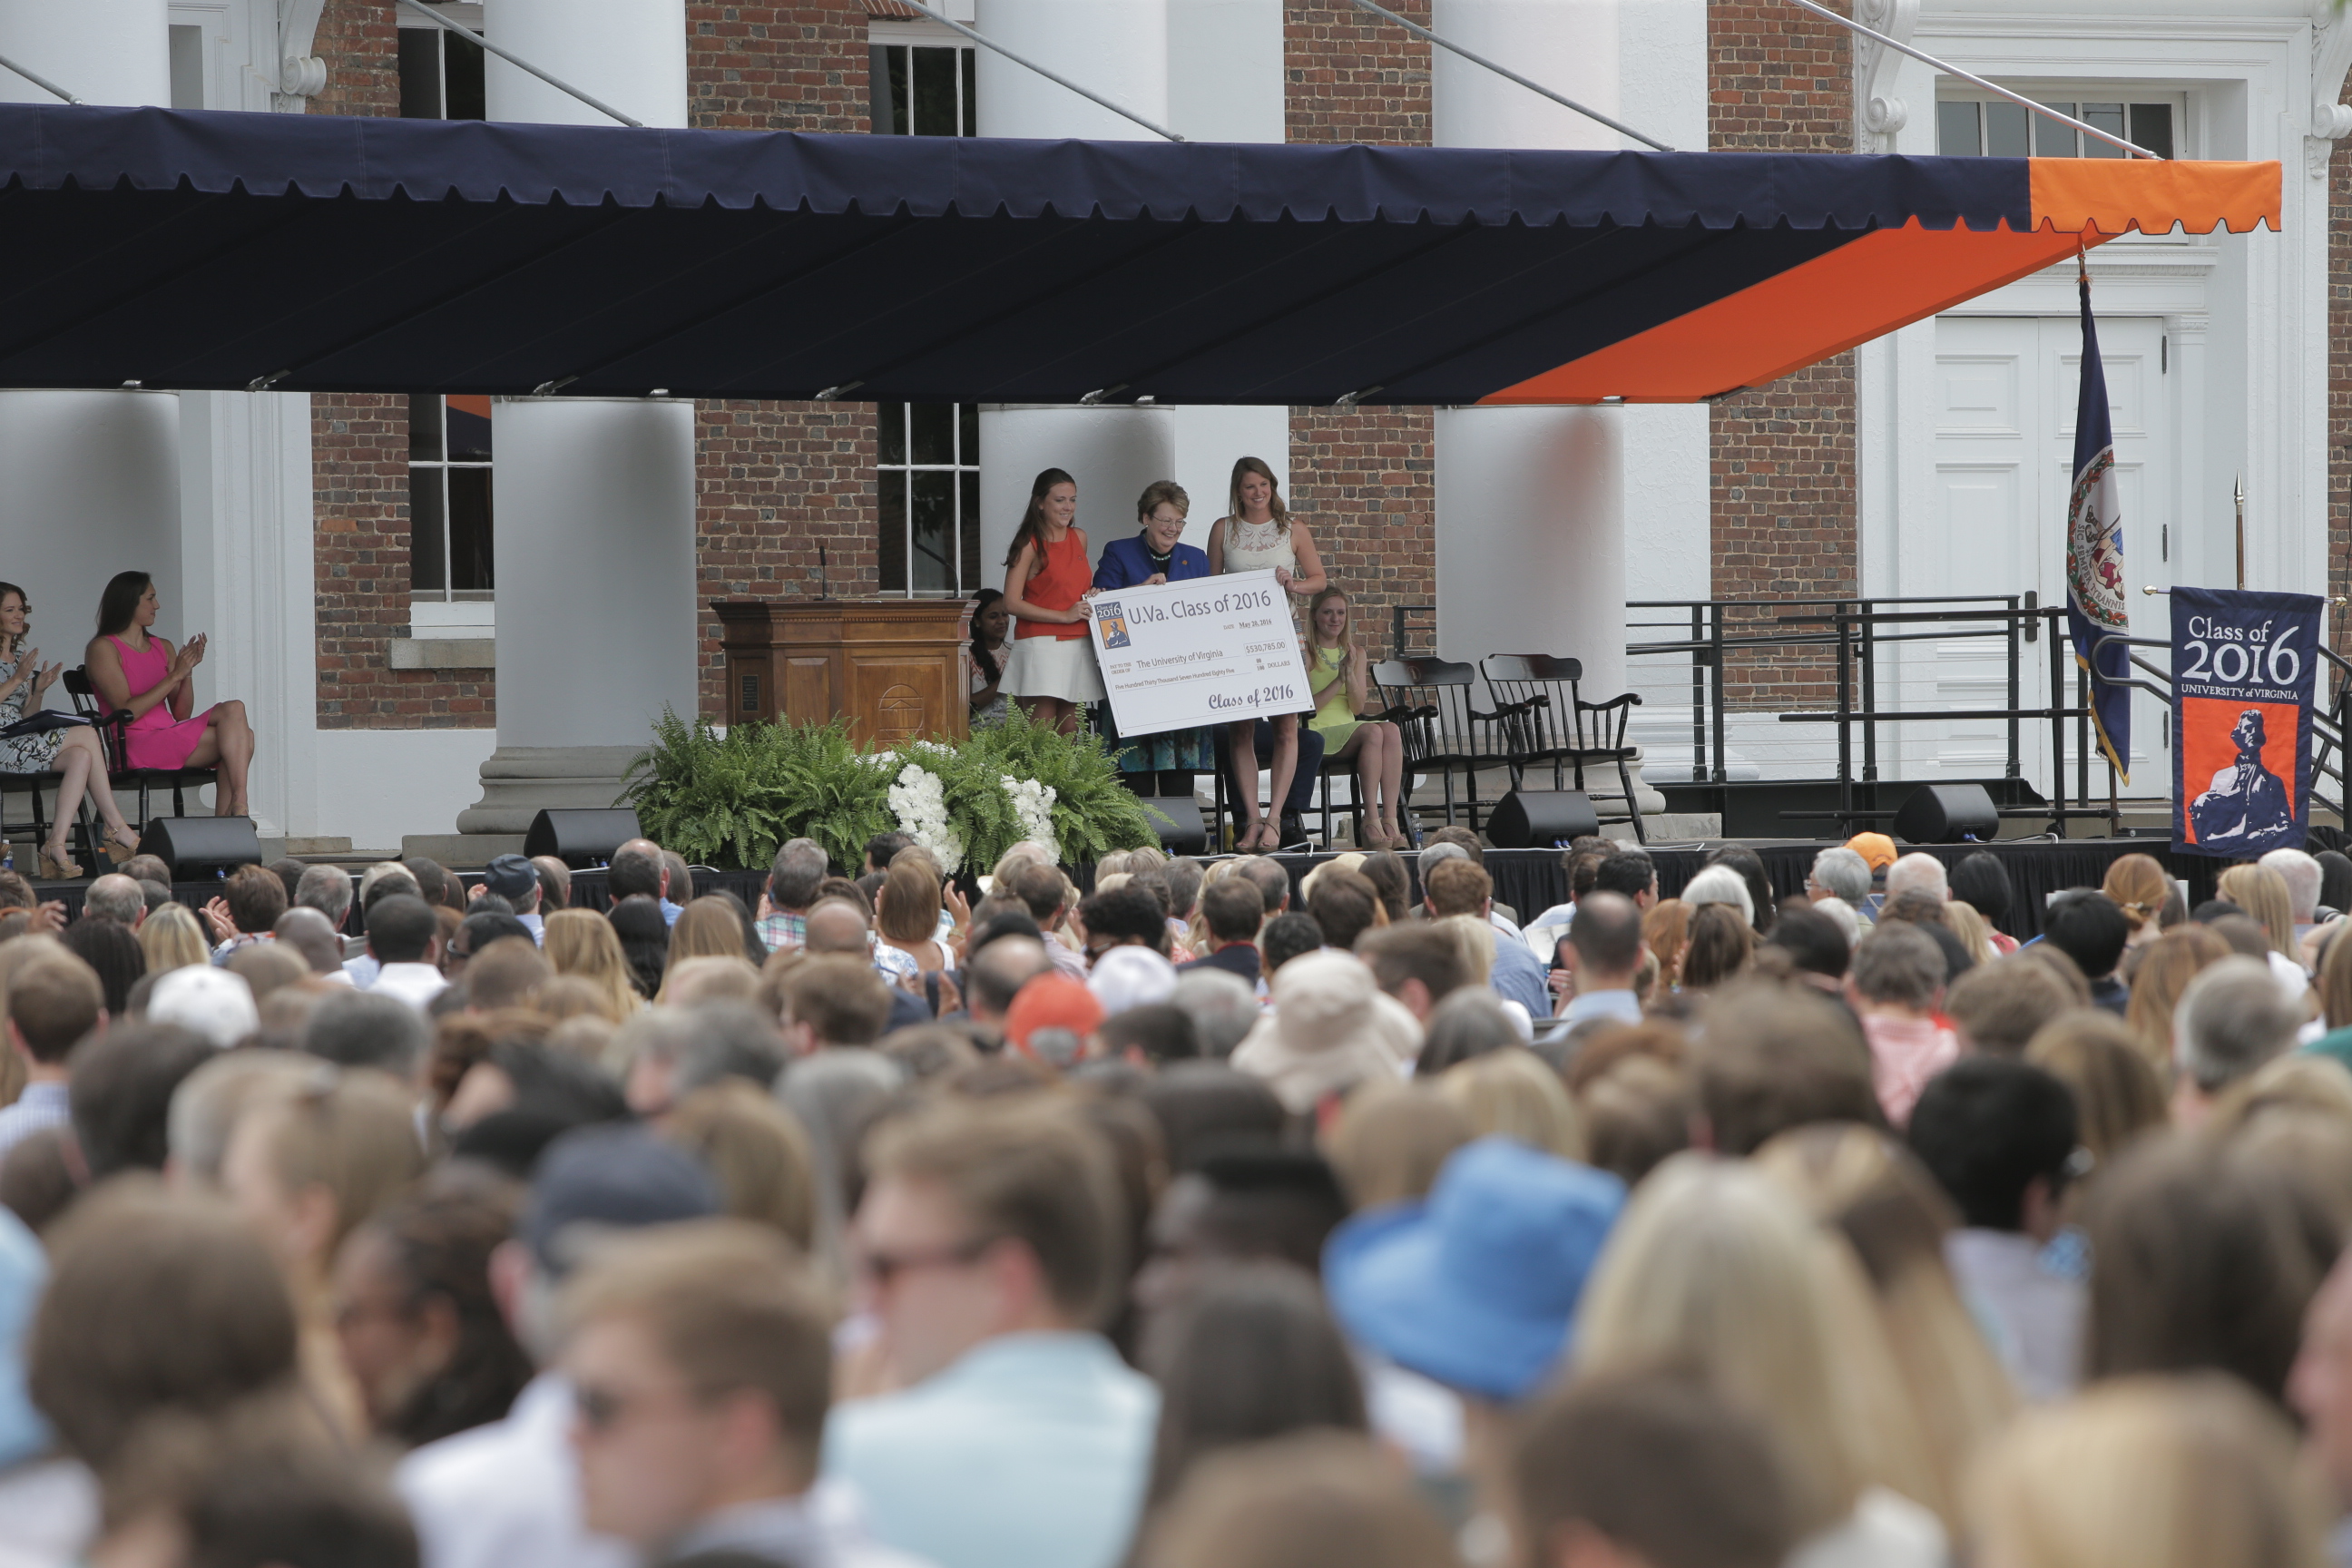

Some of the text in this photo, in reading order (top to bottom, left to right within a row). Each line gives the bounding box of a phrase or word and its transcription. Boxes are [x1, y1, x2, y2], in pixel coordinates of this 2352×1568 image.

[2077, 545, 2093, 586] SEMPER
[2090, 585, 2125, 610] TYRANNIS
[1097, 603, 1121, 618] 2016
[1128, 590, 1271, 625] U.Va. Class of 2016
[2189, 616, 2272, 642] Class of
[1137, 649, 1223, 669] The University of Virginia
[1246, 641, 1285, 654] $530,785.00
[2182, 625, 2300, 685] 2016
[1267, 660, 1291, 669] DOLLARS
[1208, 684, 1294, 710] Class of 2016
[2181, 684, 2298, 701] UNIVERSITY of VIRGINIA
